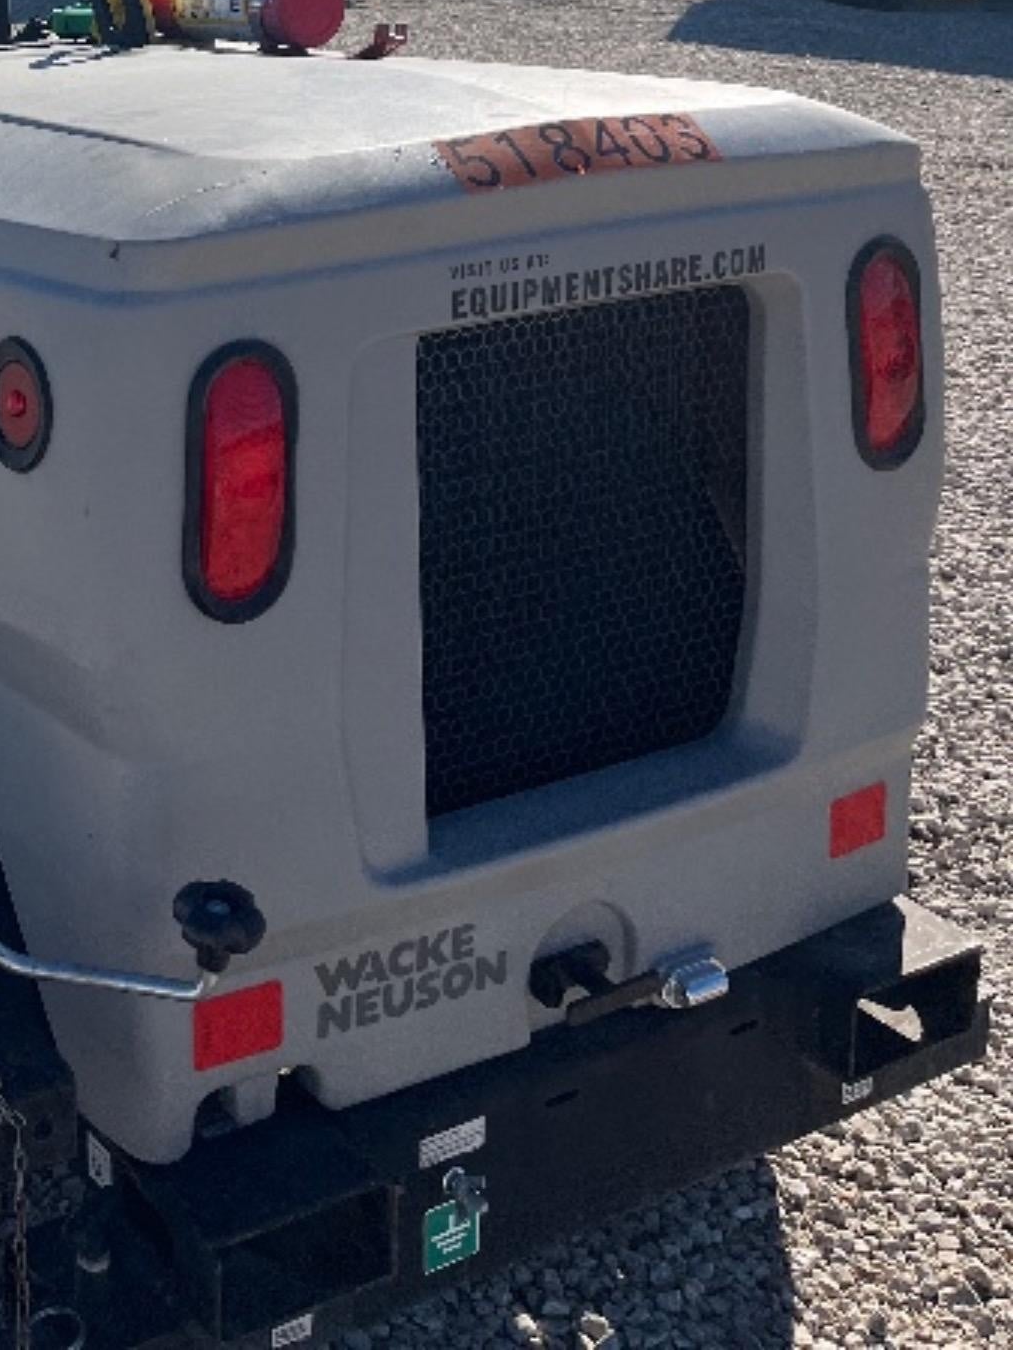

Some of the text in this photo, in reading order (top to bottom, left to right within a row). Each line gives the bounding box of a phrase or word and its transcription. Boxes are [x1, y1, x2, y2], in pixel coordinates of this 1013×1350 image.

[445, 113, 711, 188] 518403
[449, 259, 492, 281] VISIT
[499, 256, 520, 275] US
[451, 243, 766, 321] EQUIPMENTSHARE.COM
[314, 922, 476, 997] WACKE
[316, 950, 508, 1039] NEUSON
